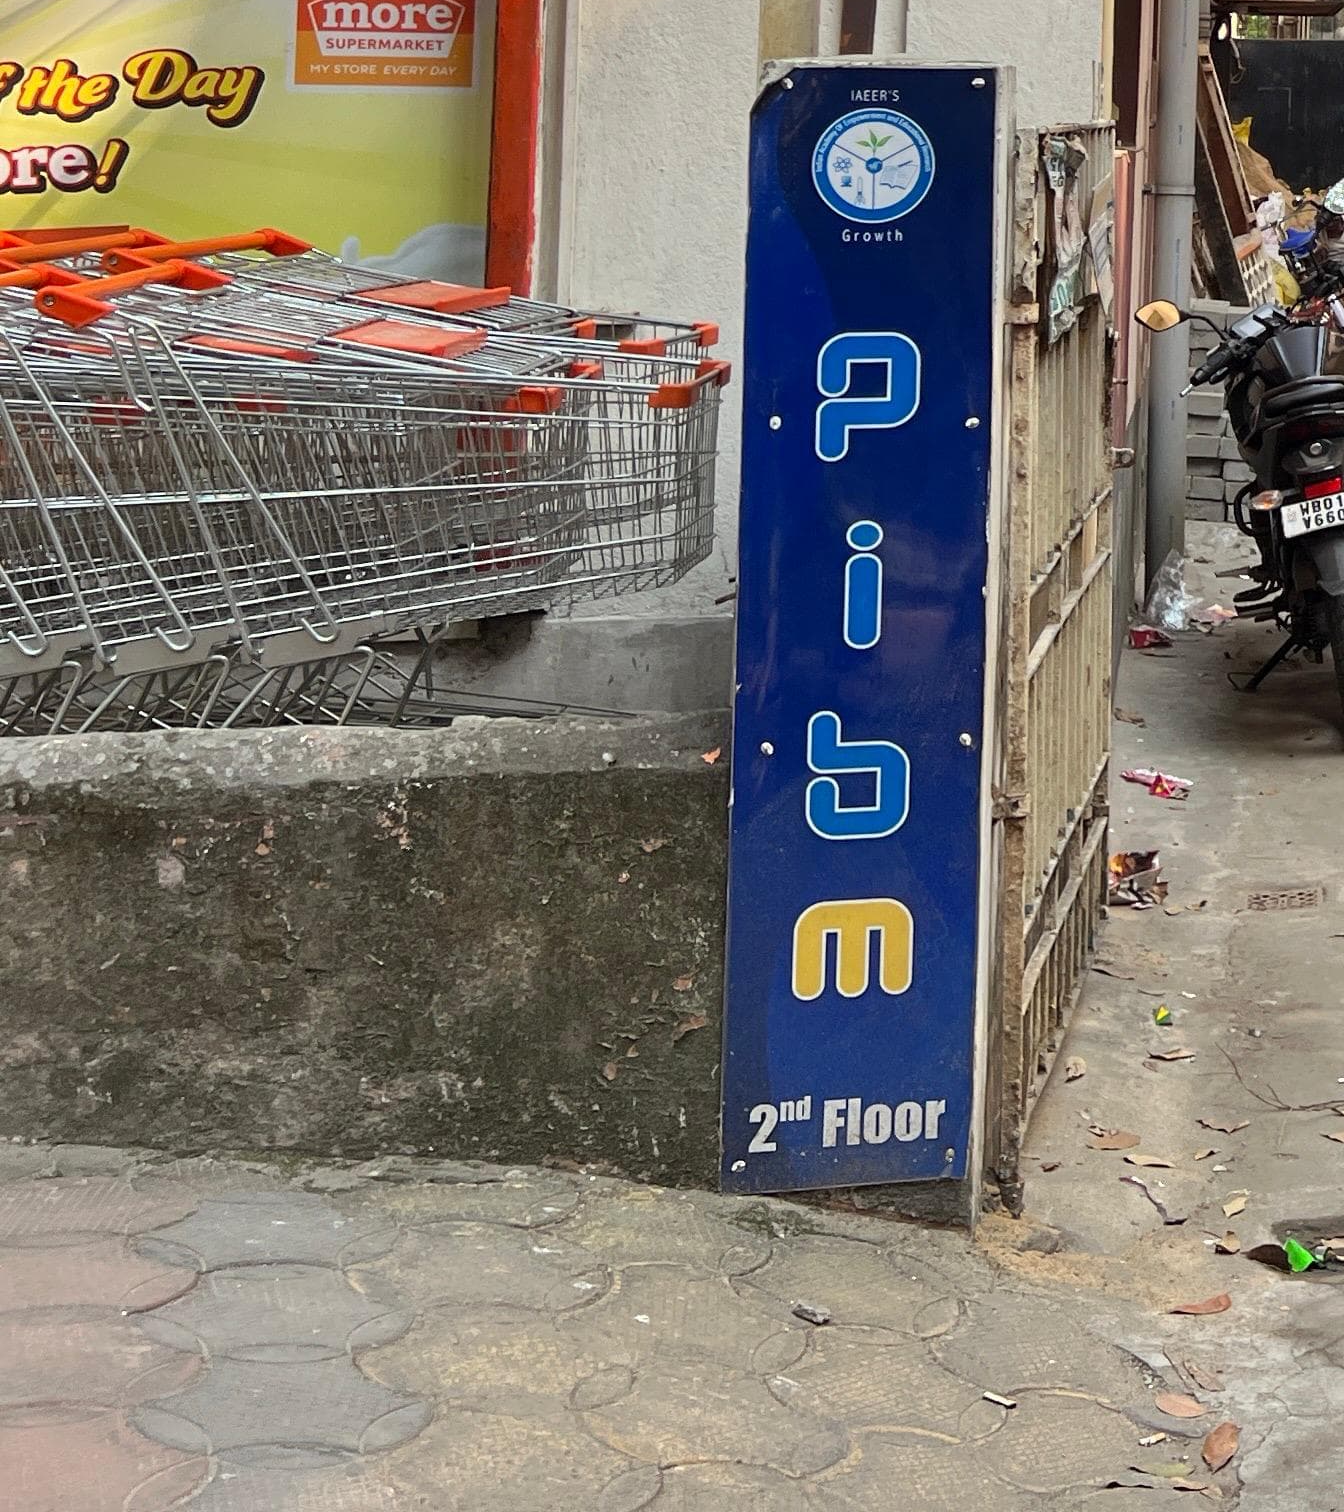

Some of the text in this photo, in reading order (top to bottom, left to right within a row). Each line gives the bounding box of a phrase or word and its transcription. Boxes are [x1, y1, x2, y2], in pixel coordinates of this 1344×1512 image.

[322, 1, 454, 31] more
[326, 38, 445, 51] SUPERMARKET
[310, 63, 458, 76] MY STORE EVERY DAY
[17, 59, 119, 123] the
[123, 48, 265, 128] Day
[851, 89, 900, 102] IAEER'S
[0, 138, 129, 194] re!
[842, 229, 904, 242] Growth
[748, 1094, 946, 1154] 2nd Floor
